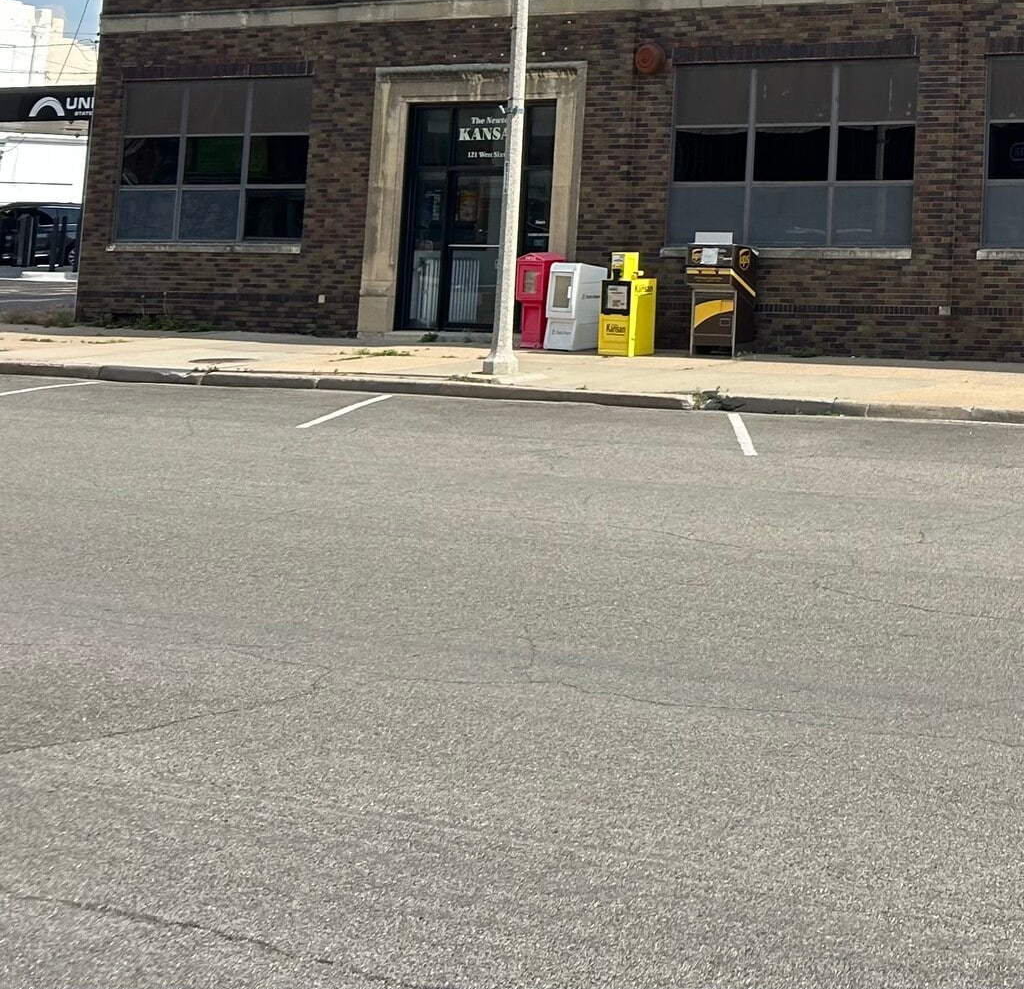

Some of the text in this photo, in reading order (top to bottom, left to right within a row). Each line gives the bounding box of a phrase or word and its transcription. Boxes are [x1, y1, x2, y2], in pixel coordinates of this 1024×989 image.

[486, 116, 508, 124] Newto
[459, 127, 508, 141] KANSA
[606, 323, 626, 333] Kansan
